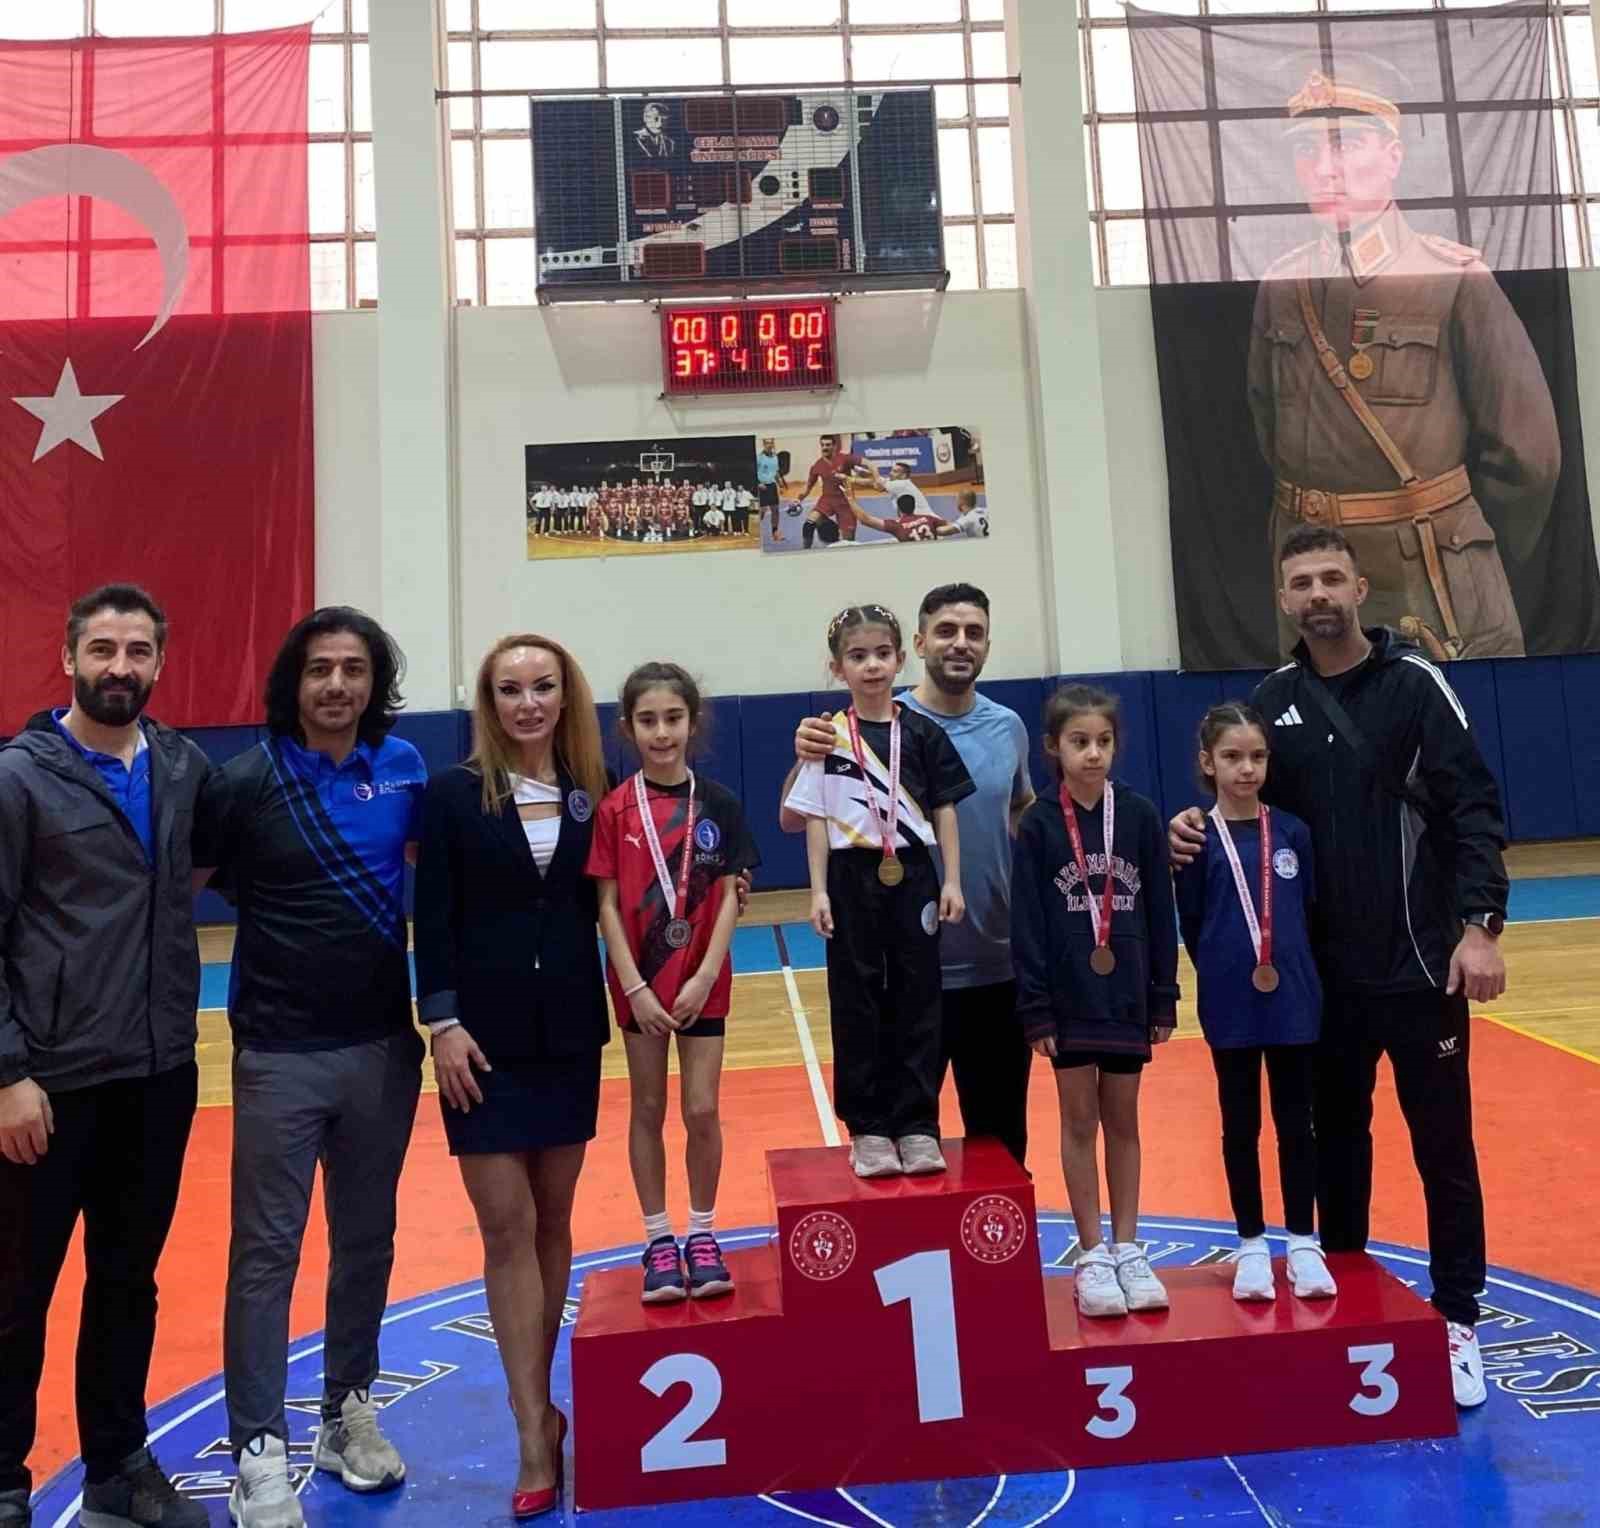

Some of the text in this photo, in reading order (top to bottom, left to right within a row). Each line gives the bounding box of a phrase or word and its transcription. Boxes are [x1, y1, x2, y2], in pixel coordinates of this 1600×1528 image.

[672, 312, 823, 344] 00 0 0 00
[767, 344, 789, 372] 16
[873, 1248, 964, 1424] 1
[638, 1352, 727, 1473] 2
[1083, 1364, 1137, 1439] 3
[1346, 1342, 1400, 1416] 3
